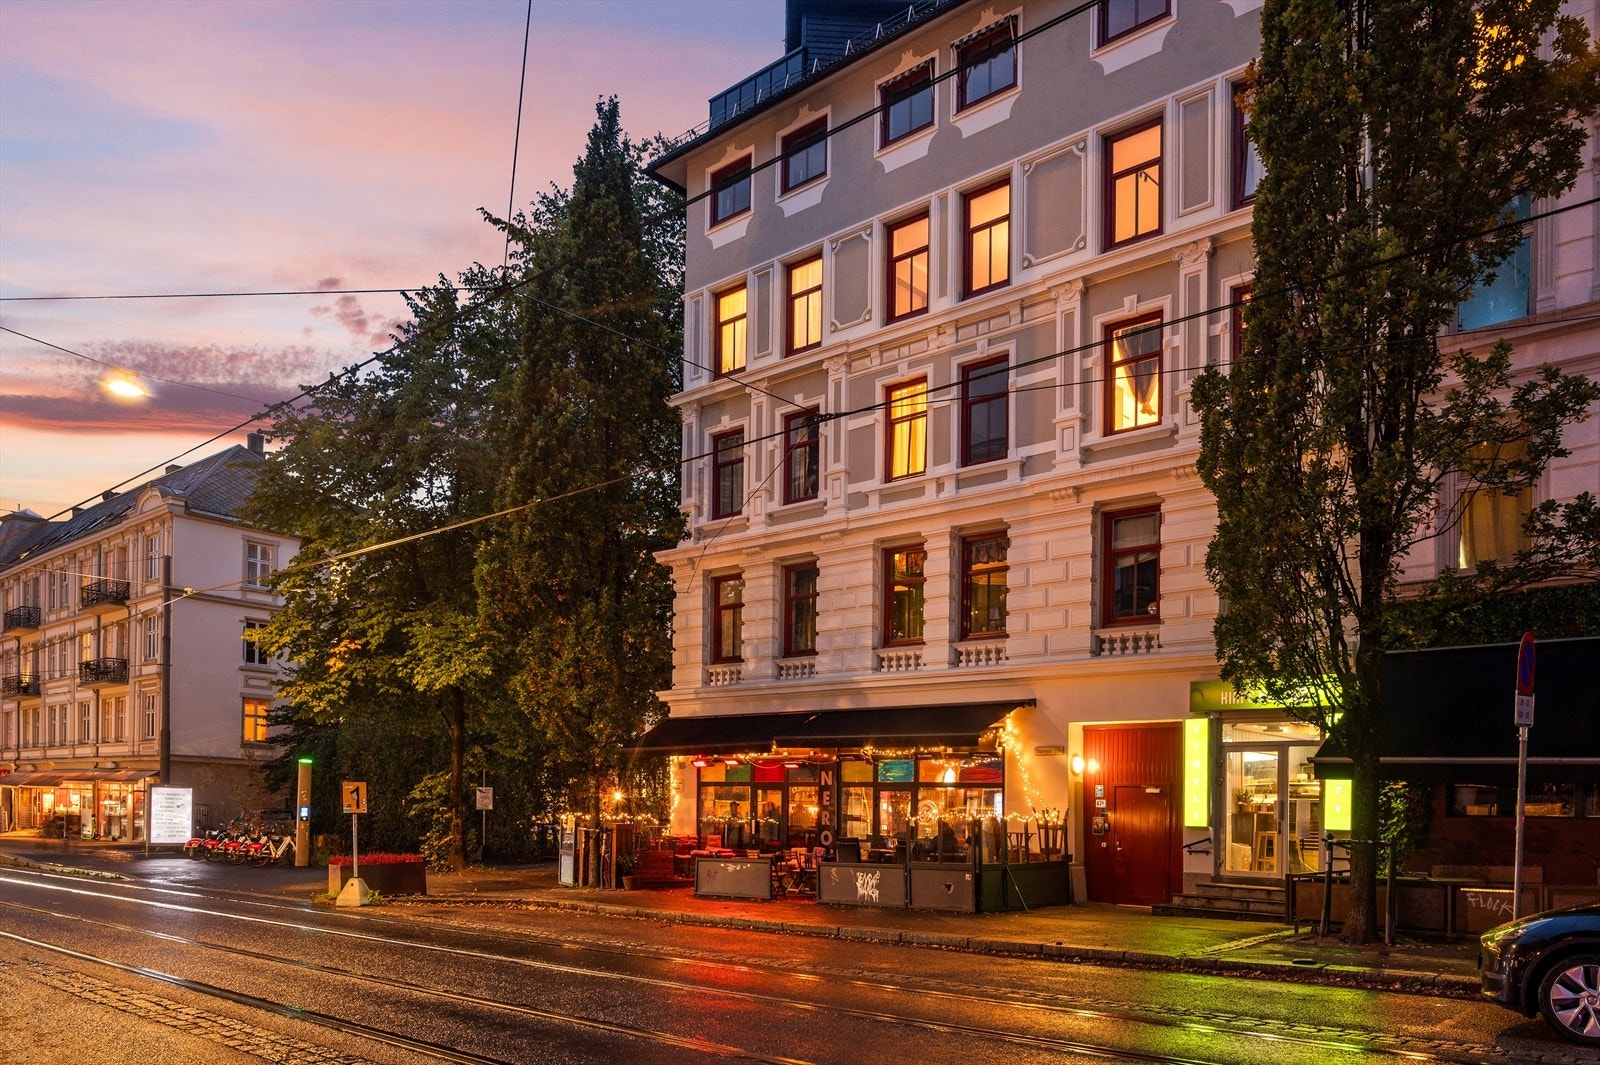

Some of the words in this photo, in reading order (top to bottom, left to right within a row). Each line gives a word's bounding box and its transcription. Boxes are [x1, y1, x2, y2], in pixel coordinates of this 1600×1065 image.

[349, 785, 360, 809] 1
[820, 770, 833, 846] NERO
[1191, 725, 1201, 820] SIMPLY
